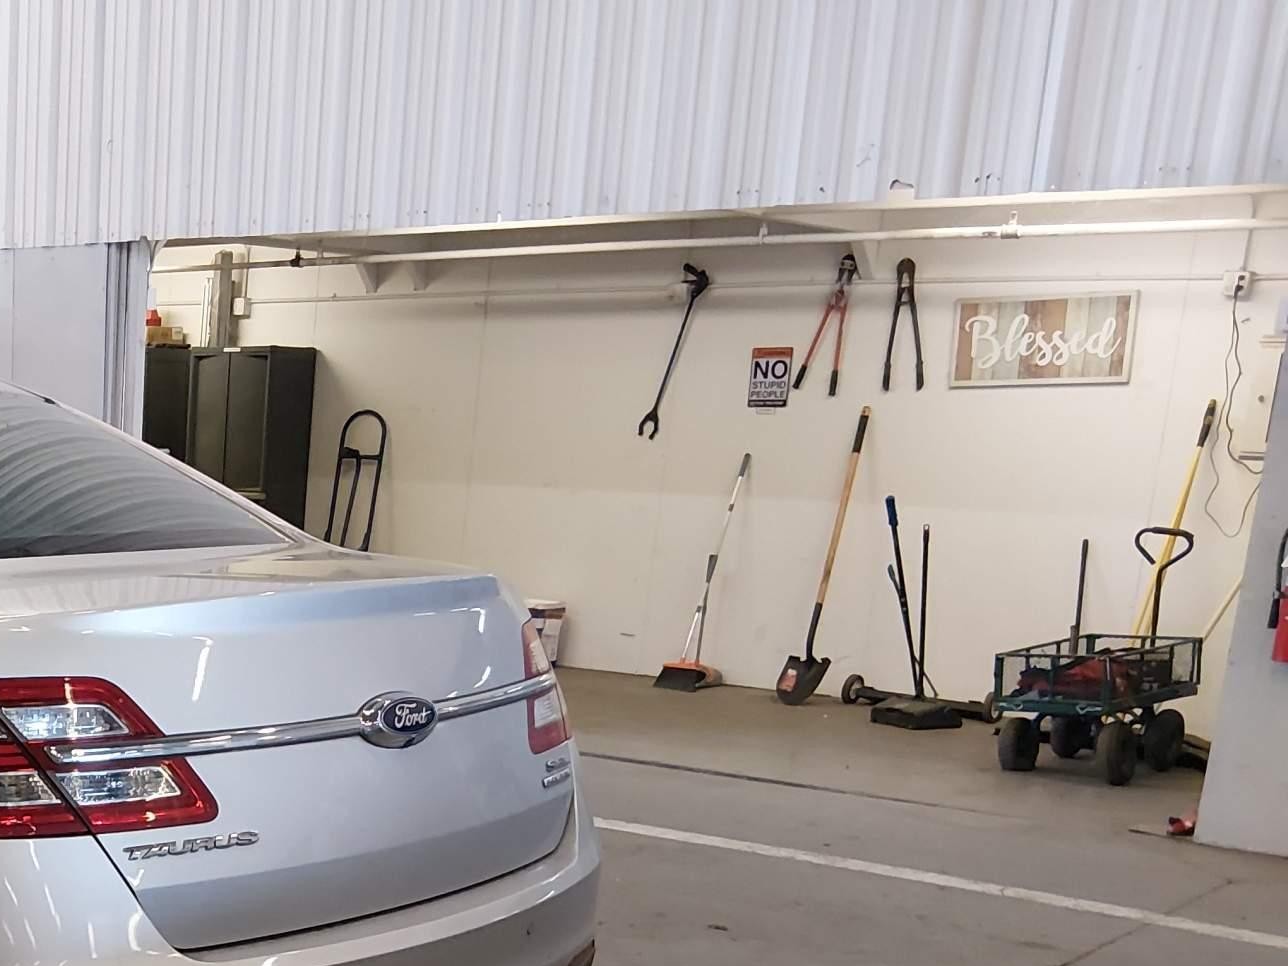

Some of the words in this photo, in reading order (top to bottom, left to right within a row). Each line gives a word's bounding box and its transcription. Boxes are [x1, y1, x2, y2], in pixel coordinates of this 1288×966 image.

[965, 313, 1122, 369] Blessed
[753, 359, 788, 379] NO
[750, 390, 785, 399] PEOPLE
[752, 380, 787, 390] STUPID
[394, 703, 431, 728] Ford
[123, 831, 259, 861] TAURUS
